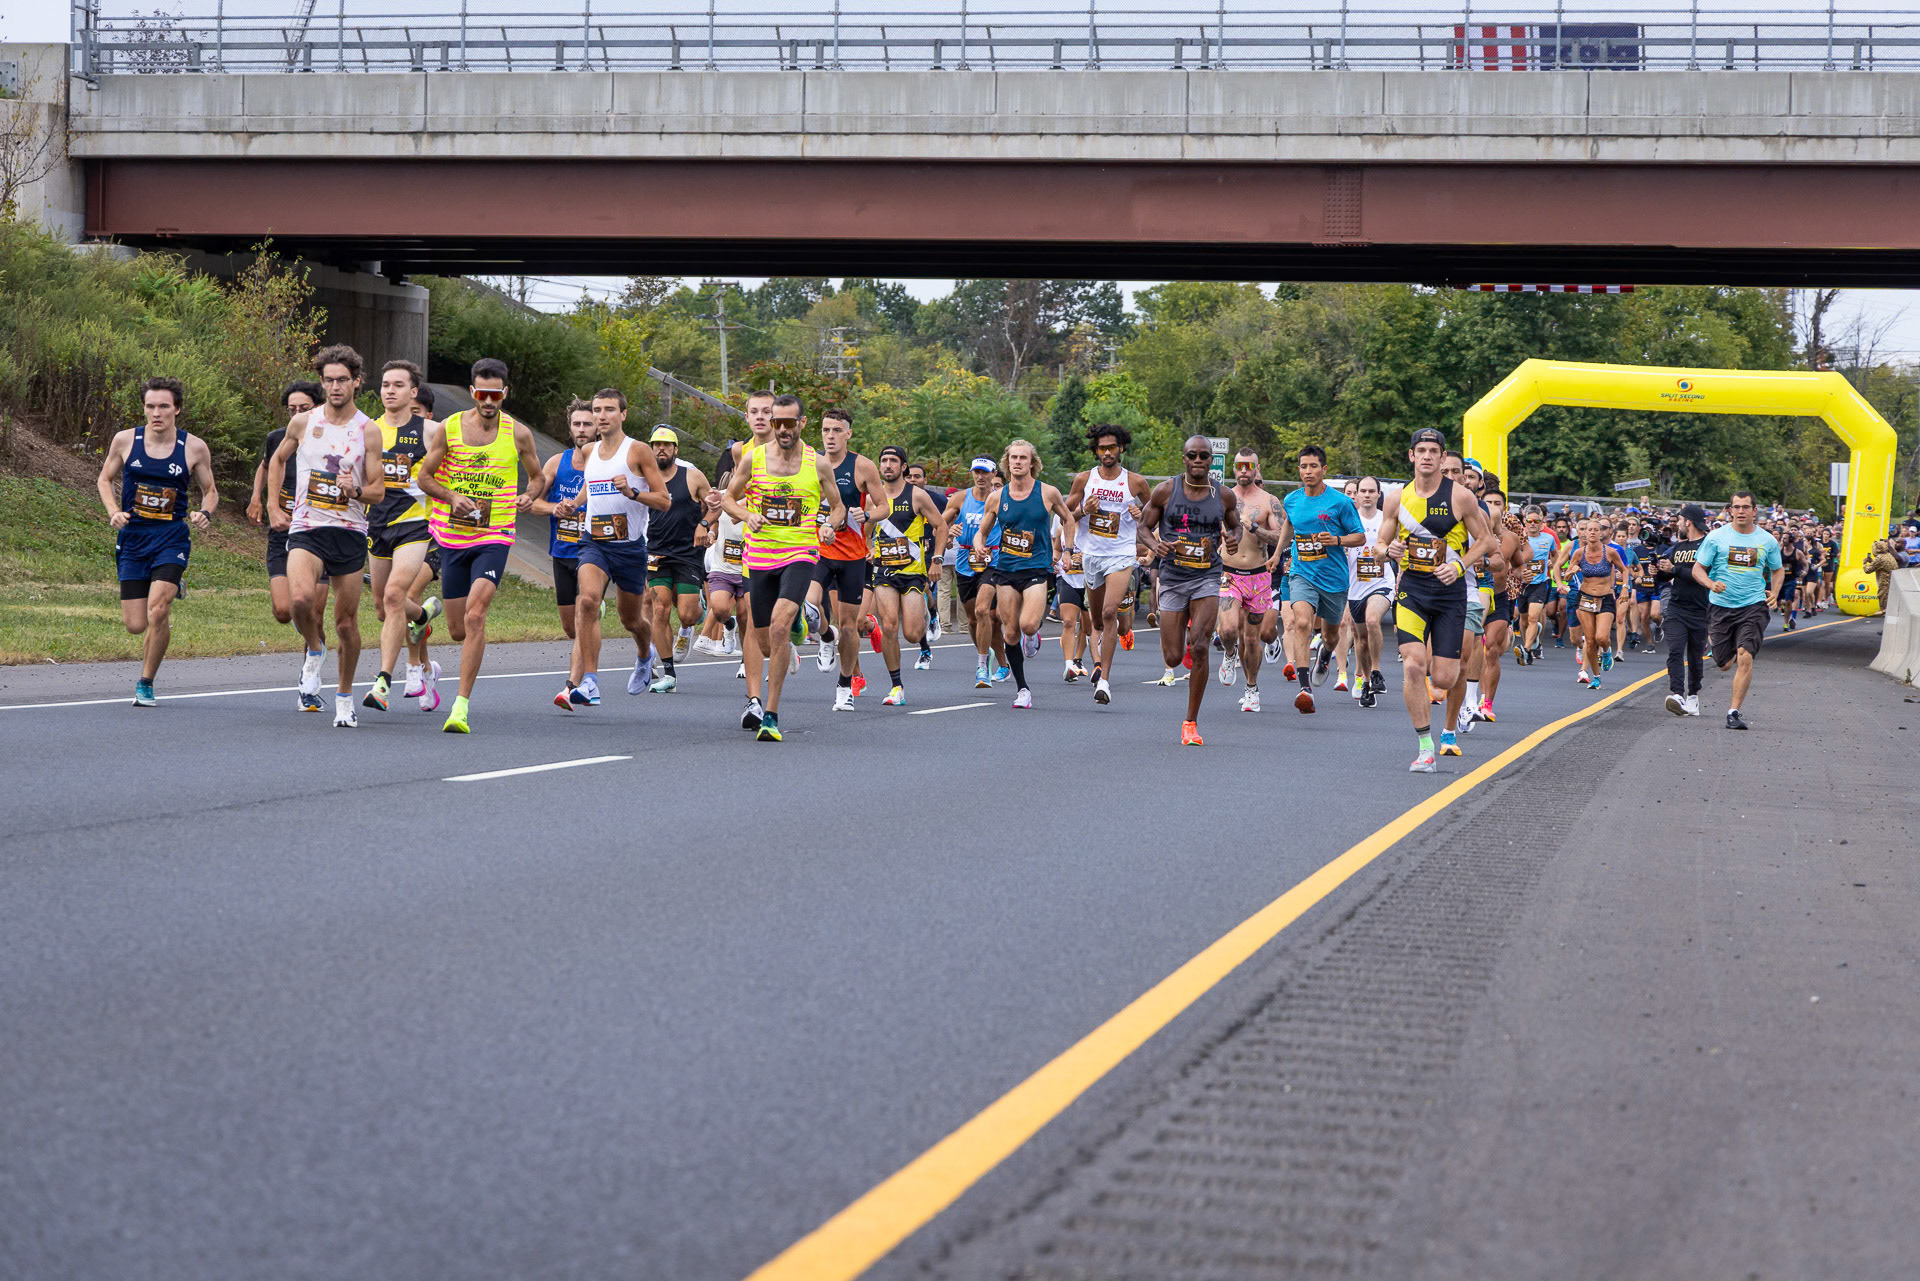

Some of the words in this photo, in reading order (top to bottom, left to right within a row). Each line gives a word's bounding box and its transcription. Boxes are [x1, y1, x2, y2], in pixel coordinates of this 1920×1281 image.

[399, 436, 418, 444] GSTC
[168, 462, 183, 476] SP
[382, 464, 408, 476] 05
[316, 482, 341, 496] 39
[469, 482, 480, 490] OF
[589, 483, 609, 492] SHORE
[472, 489, 494, 497] YORK
[1092, 488, 1124, 498] LEONIA
[142, 495, 170, 507] 137
[766, 508, 796, 520] 217
[559, 519, 586, 532] 228
[1096, 518, 1113, 528] 27
[603, 525, 614, 535] 9
[1006, 536, 1029, 548] 198
[1297, 542, 1323, 551] 233
[881, 546, 907, 556] 245
[1185, 546, 1204, 556] 75
[1416, 548, 1438, 559] 97
[1360, 565, 1381, 573] 212
